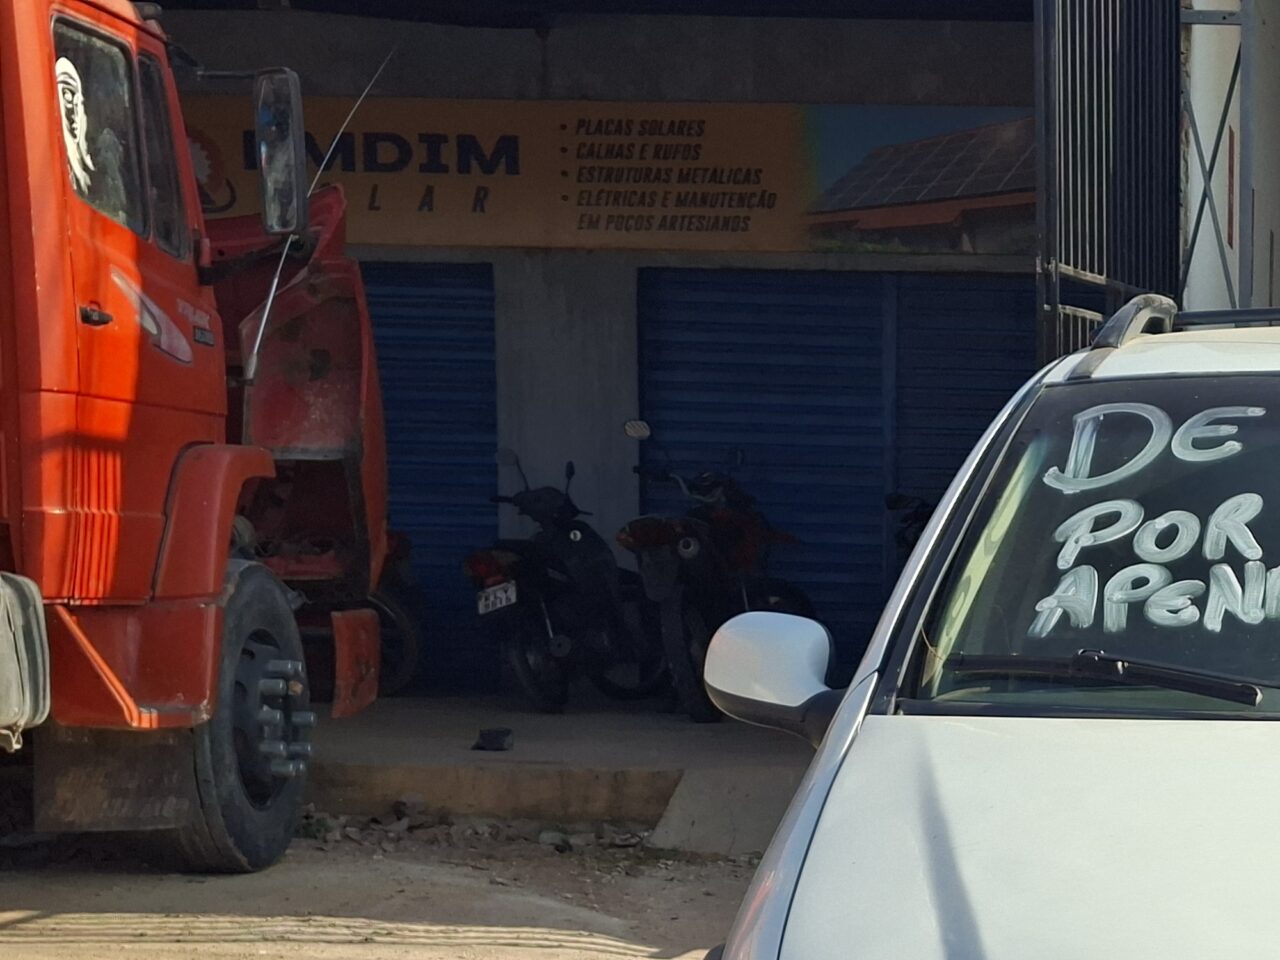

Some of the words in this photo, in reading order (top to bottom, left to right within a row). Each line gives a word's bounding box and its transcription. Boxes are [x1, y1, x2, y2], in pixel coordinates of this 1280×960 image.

[576, 119, 634, 137] PLACAS
[638, 119, 706, 138] SOLARES
[243, 130, 520, 175] MDIM
[576, 142, 635, 161] CALHAS
[640, 143, 649, 161] E
[652, 143, 702, 161] RUFOS
[576, 166, 673, 184] ESTRUTURAS
[660, 191, 670, 208] E
[674, 189, 778, 209] MANUTENÇÃO
[577, 213, 600, 231] EM
[605, 214, 656, 233] POÇOS
[656, 214, 751, 232] ARTESIANOS
[1043, 401, 1267, 494] DE
[1054, 492, 1263, 570] POR
